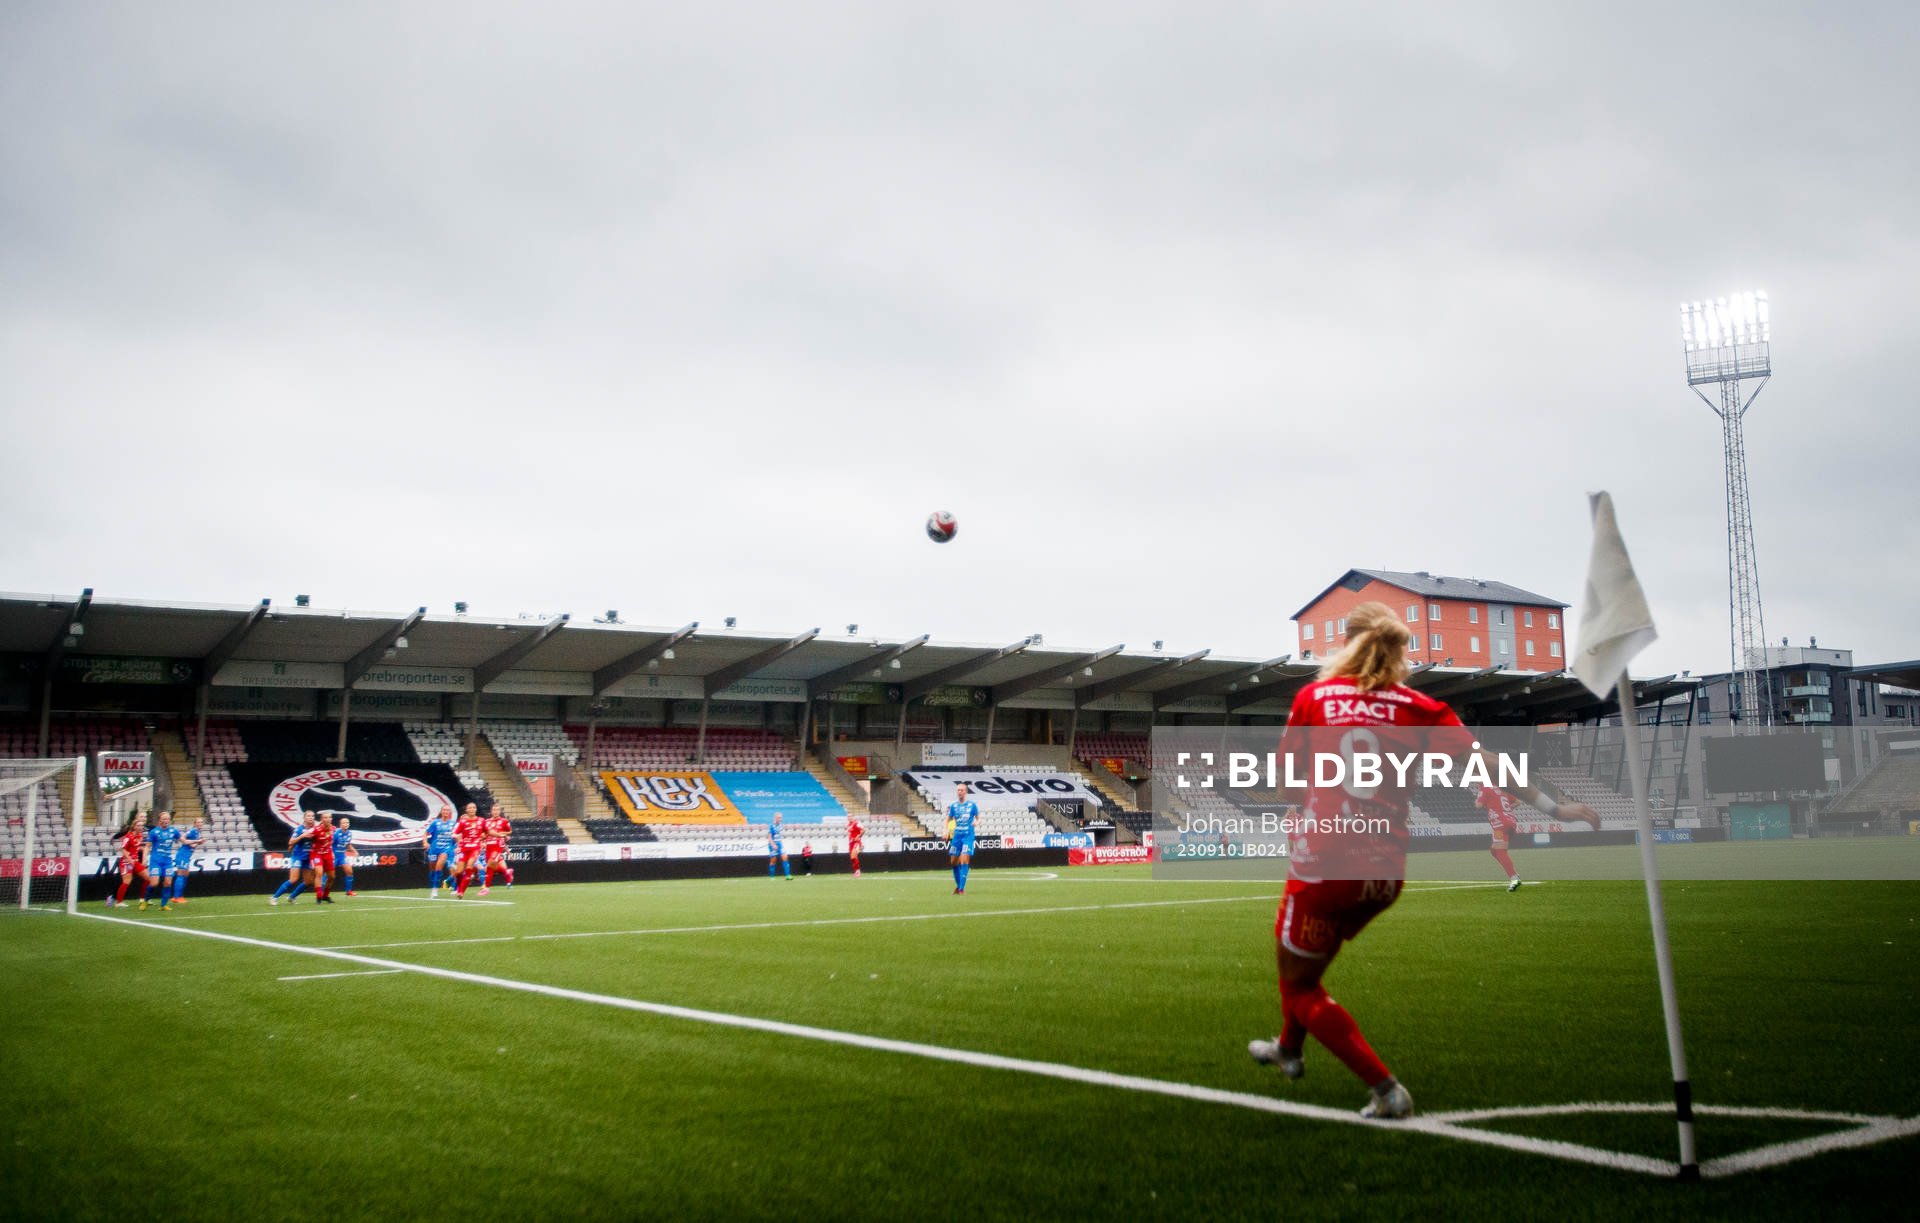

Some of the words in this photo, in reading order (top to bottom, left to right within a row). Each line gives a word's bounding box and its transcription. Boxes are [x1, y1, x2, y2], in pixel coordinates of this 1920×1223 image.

[1324, 699, 1397, 720] EXACT
[281, 769, 382, 792] ÖREBRO
[276, 792, 296, 812] KIF
[1096, 847, 1148, 858] BYGG-STRÖM
